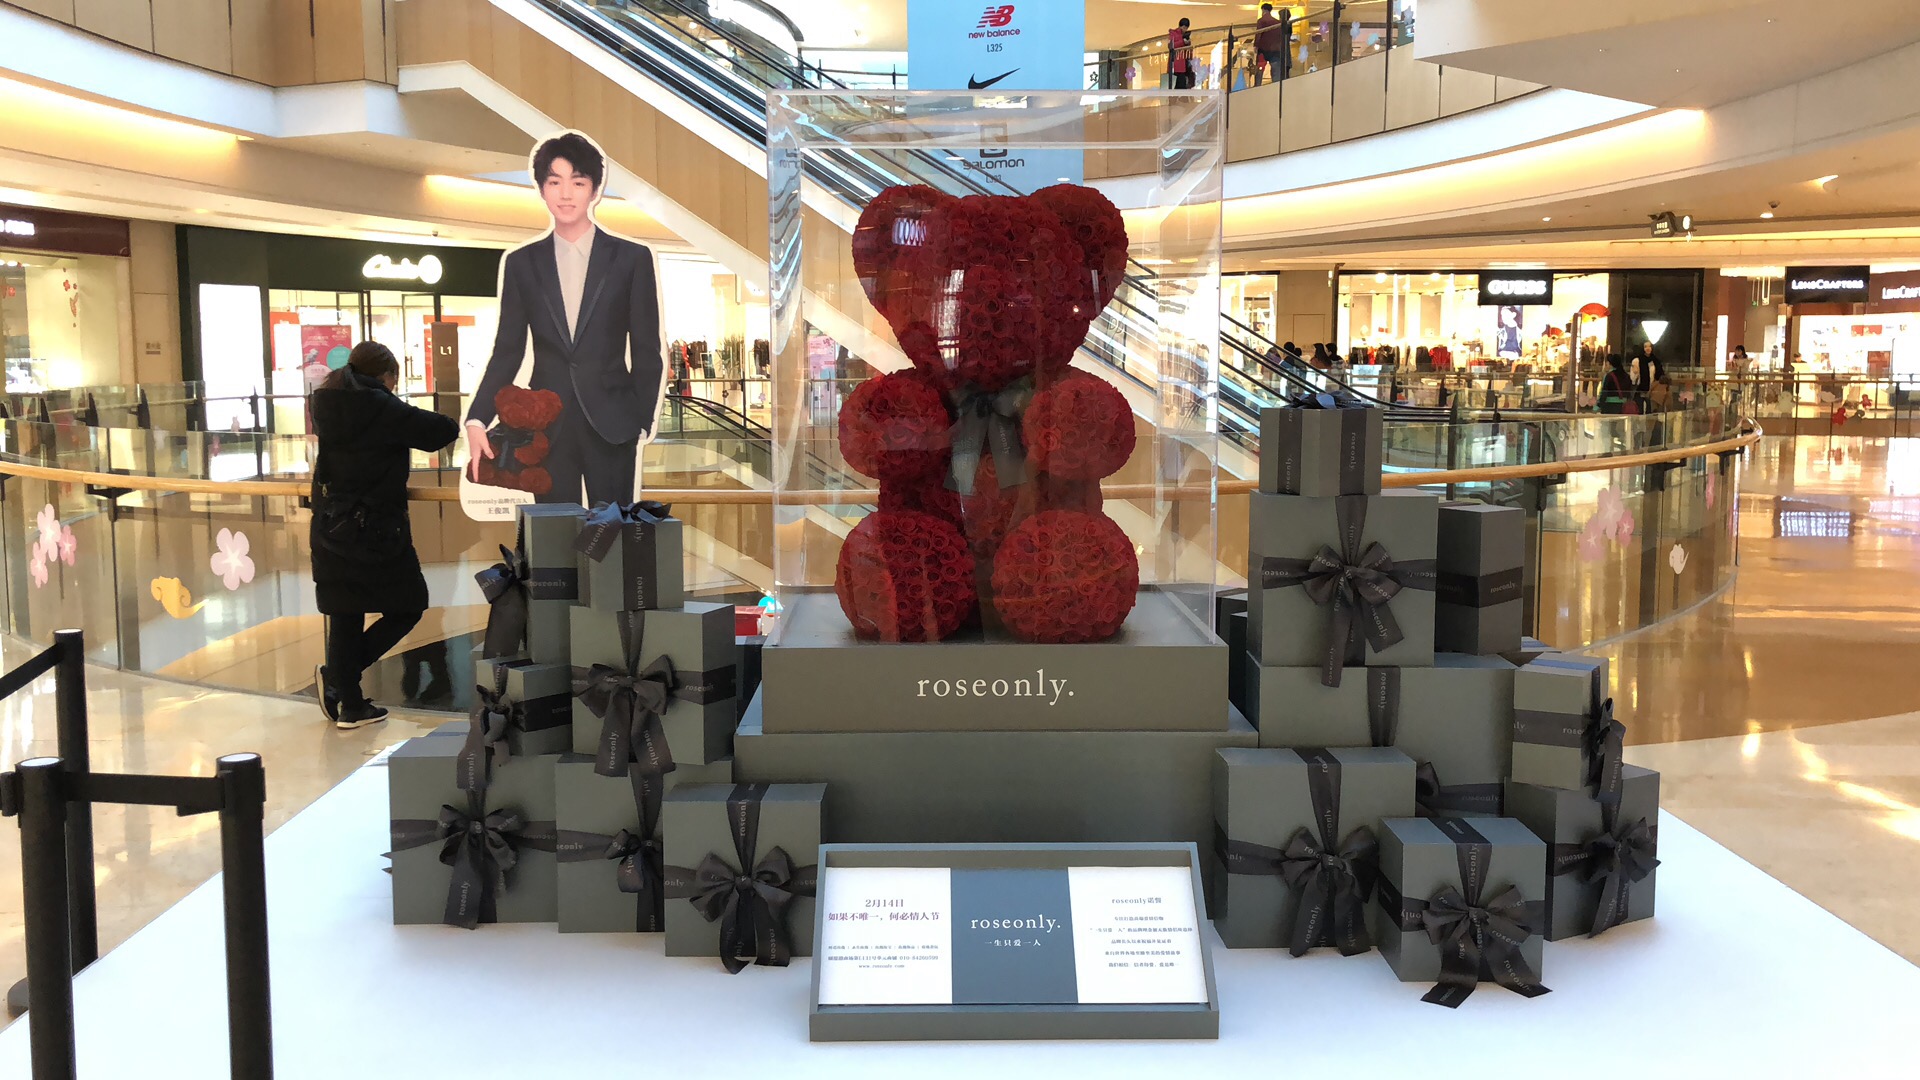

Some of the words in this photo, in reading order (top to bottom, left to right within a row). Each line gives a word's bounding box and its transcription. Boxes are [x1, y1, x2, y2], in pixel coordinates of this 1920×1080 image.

[968, 31, 985, 39] new
[986, 28, 1021, 38] balance
[986, 43, 1003, 53] L325
[440, 345, 452, 355] L1
[917, 669, 1074, 706] roseonly.
[865, 899, 904, 907] 2月14日
[970, 914, 1061, 933] roseonly.
[984, 939, 1041, 947] 一生只爱一人
